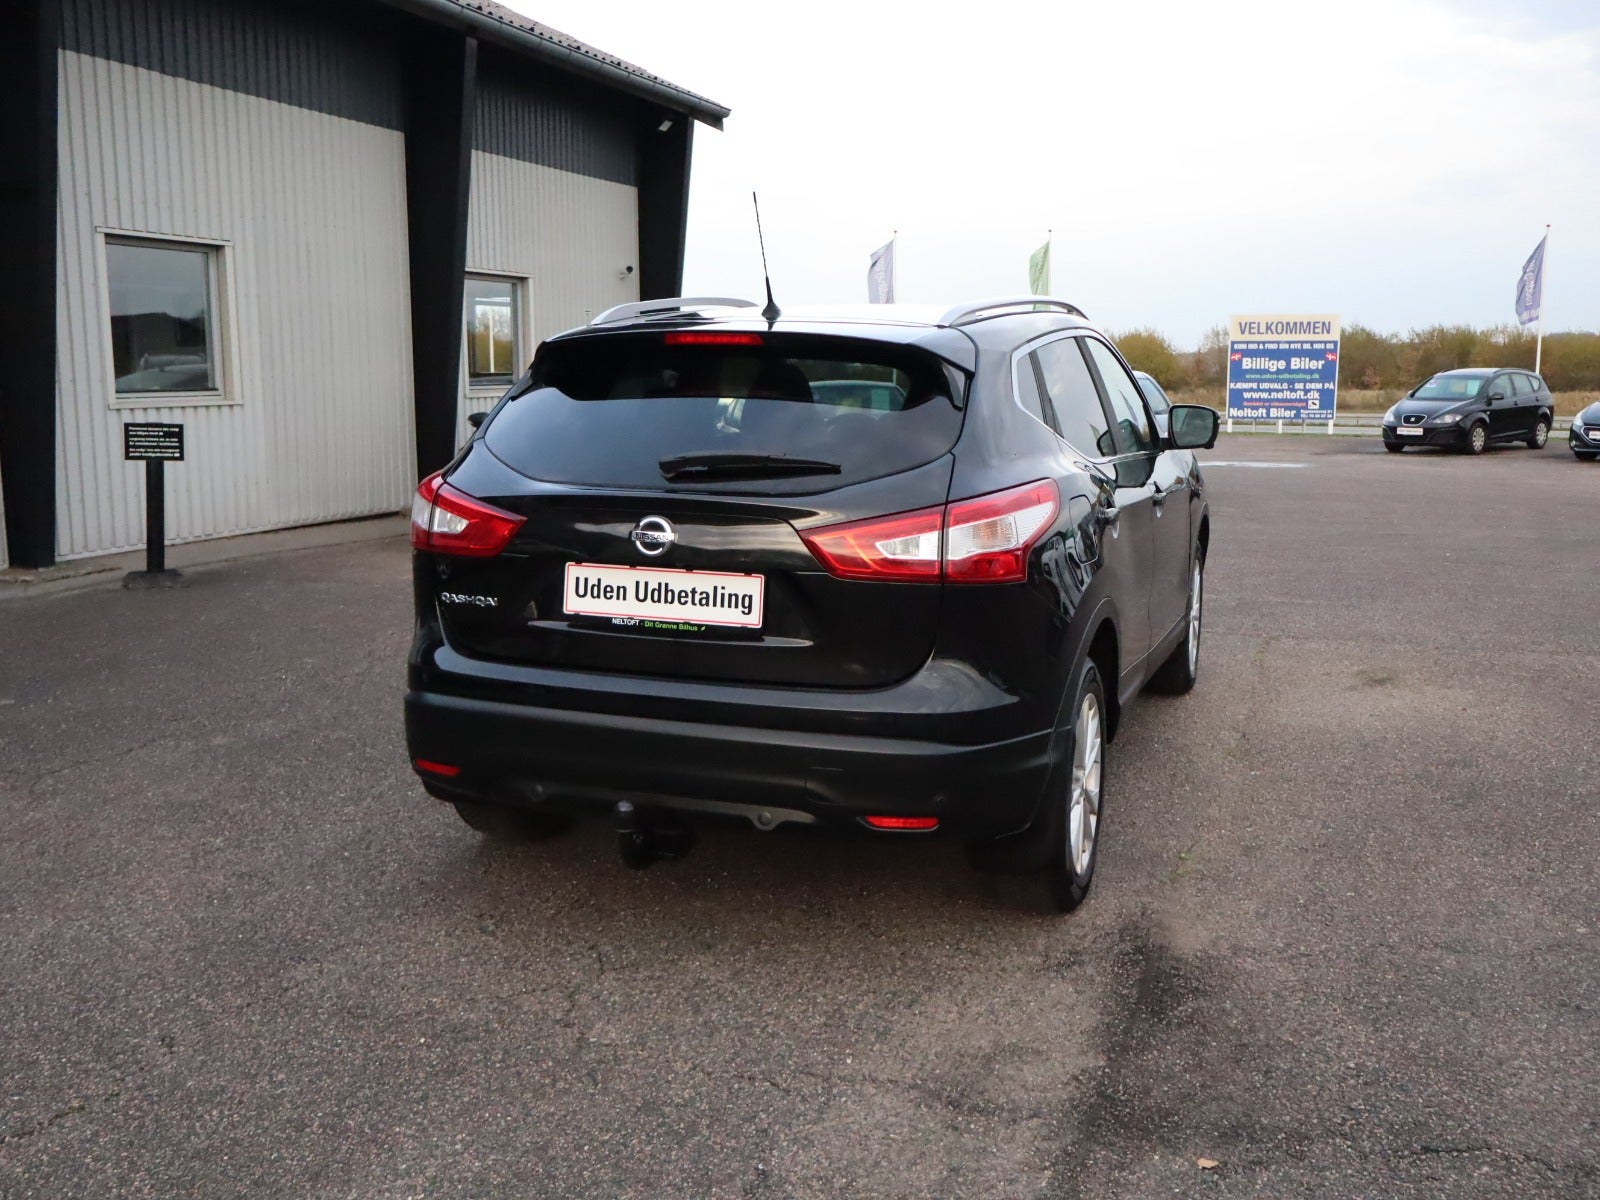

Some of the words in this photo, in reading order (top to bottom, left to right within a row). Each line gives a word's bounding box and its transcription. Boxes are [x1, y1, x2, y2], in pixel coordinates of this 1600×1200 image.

[1239, 321, 1331, 335] VELKOMMEN
[1242, 357, 1286, 371] Billige
[1290, 357, 1325, 370] Biler
[1324, 381, 1334, 389] PÅ
[1243, 390, 1320, 399] www.neltoft.dk
[1229, 408, 1267, 417] Neltoft
[1270, 408, 1297, 418] Biler
[635, 533, 670, 541] NISSAN
[441, 591, 498, 607] QASHQAI
[574, 576, 627, 601] Uden
[634, 580, 754, 615] Udbetaling
[612, 617, 640, 626] NELTOFT
[678, 623, 698, 631] Bilhus
